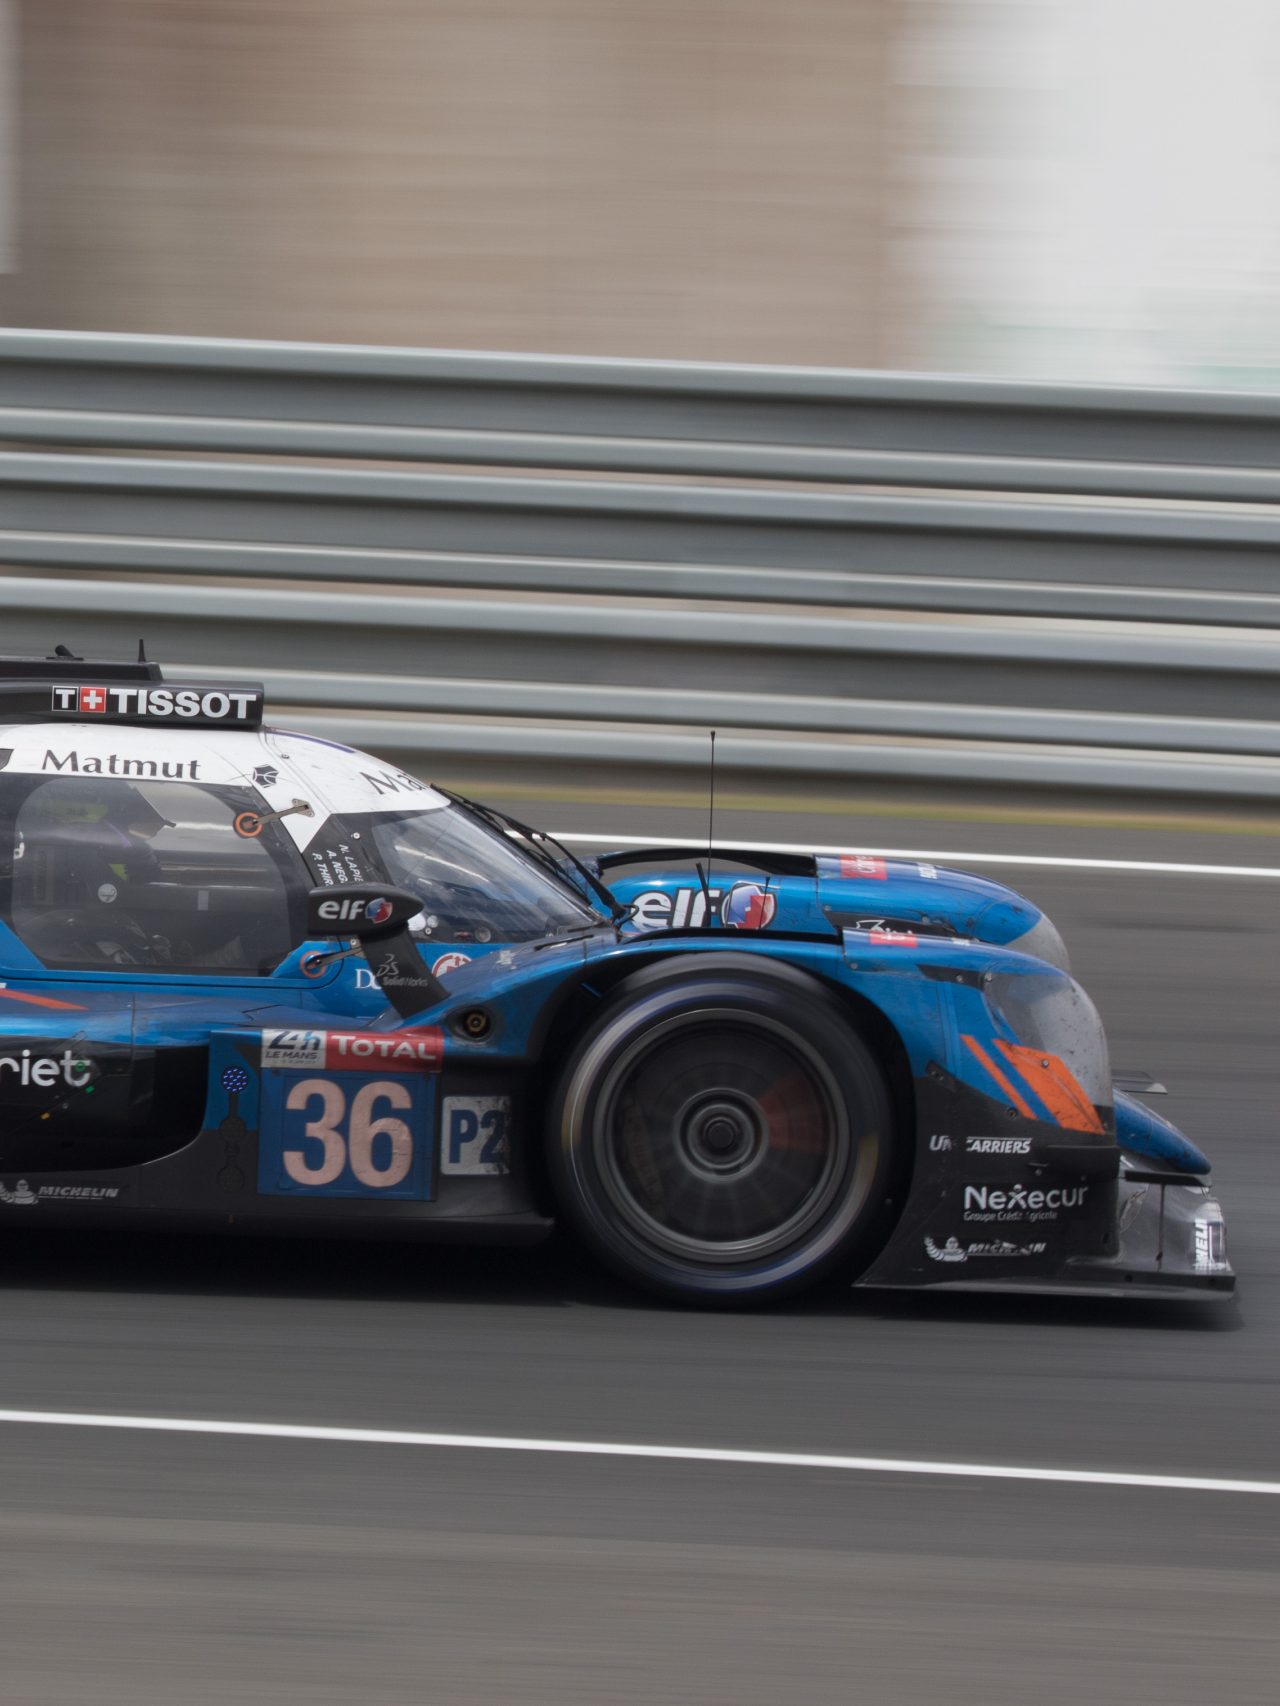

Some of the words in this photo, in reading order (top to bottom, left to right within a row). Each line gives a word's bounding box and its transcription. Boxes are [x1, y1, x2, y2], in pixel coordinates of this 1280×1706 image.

[109, 688, 257, 719] TISSOT
[41, 749, 201, 781] Matmut
[326, 849, 337, 860] A.
[317, 899, 366, 921] elf
[632, 889, 721, 928] elf
[265, 1051, 281, 1059] LE
[282, 1051, 318, 1060] MANS
[269, 1030, 320, 1051] 24h
[331, 1034, 437, 1061] TOTAL
[282, 1078, 414, 1188] 36
[448, 1108, 507, 1164] P2
[38, 1186, 120, 1198] MICHELIN
[963, 1183, 1089, 1210] Nexecur
